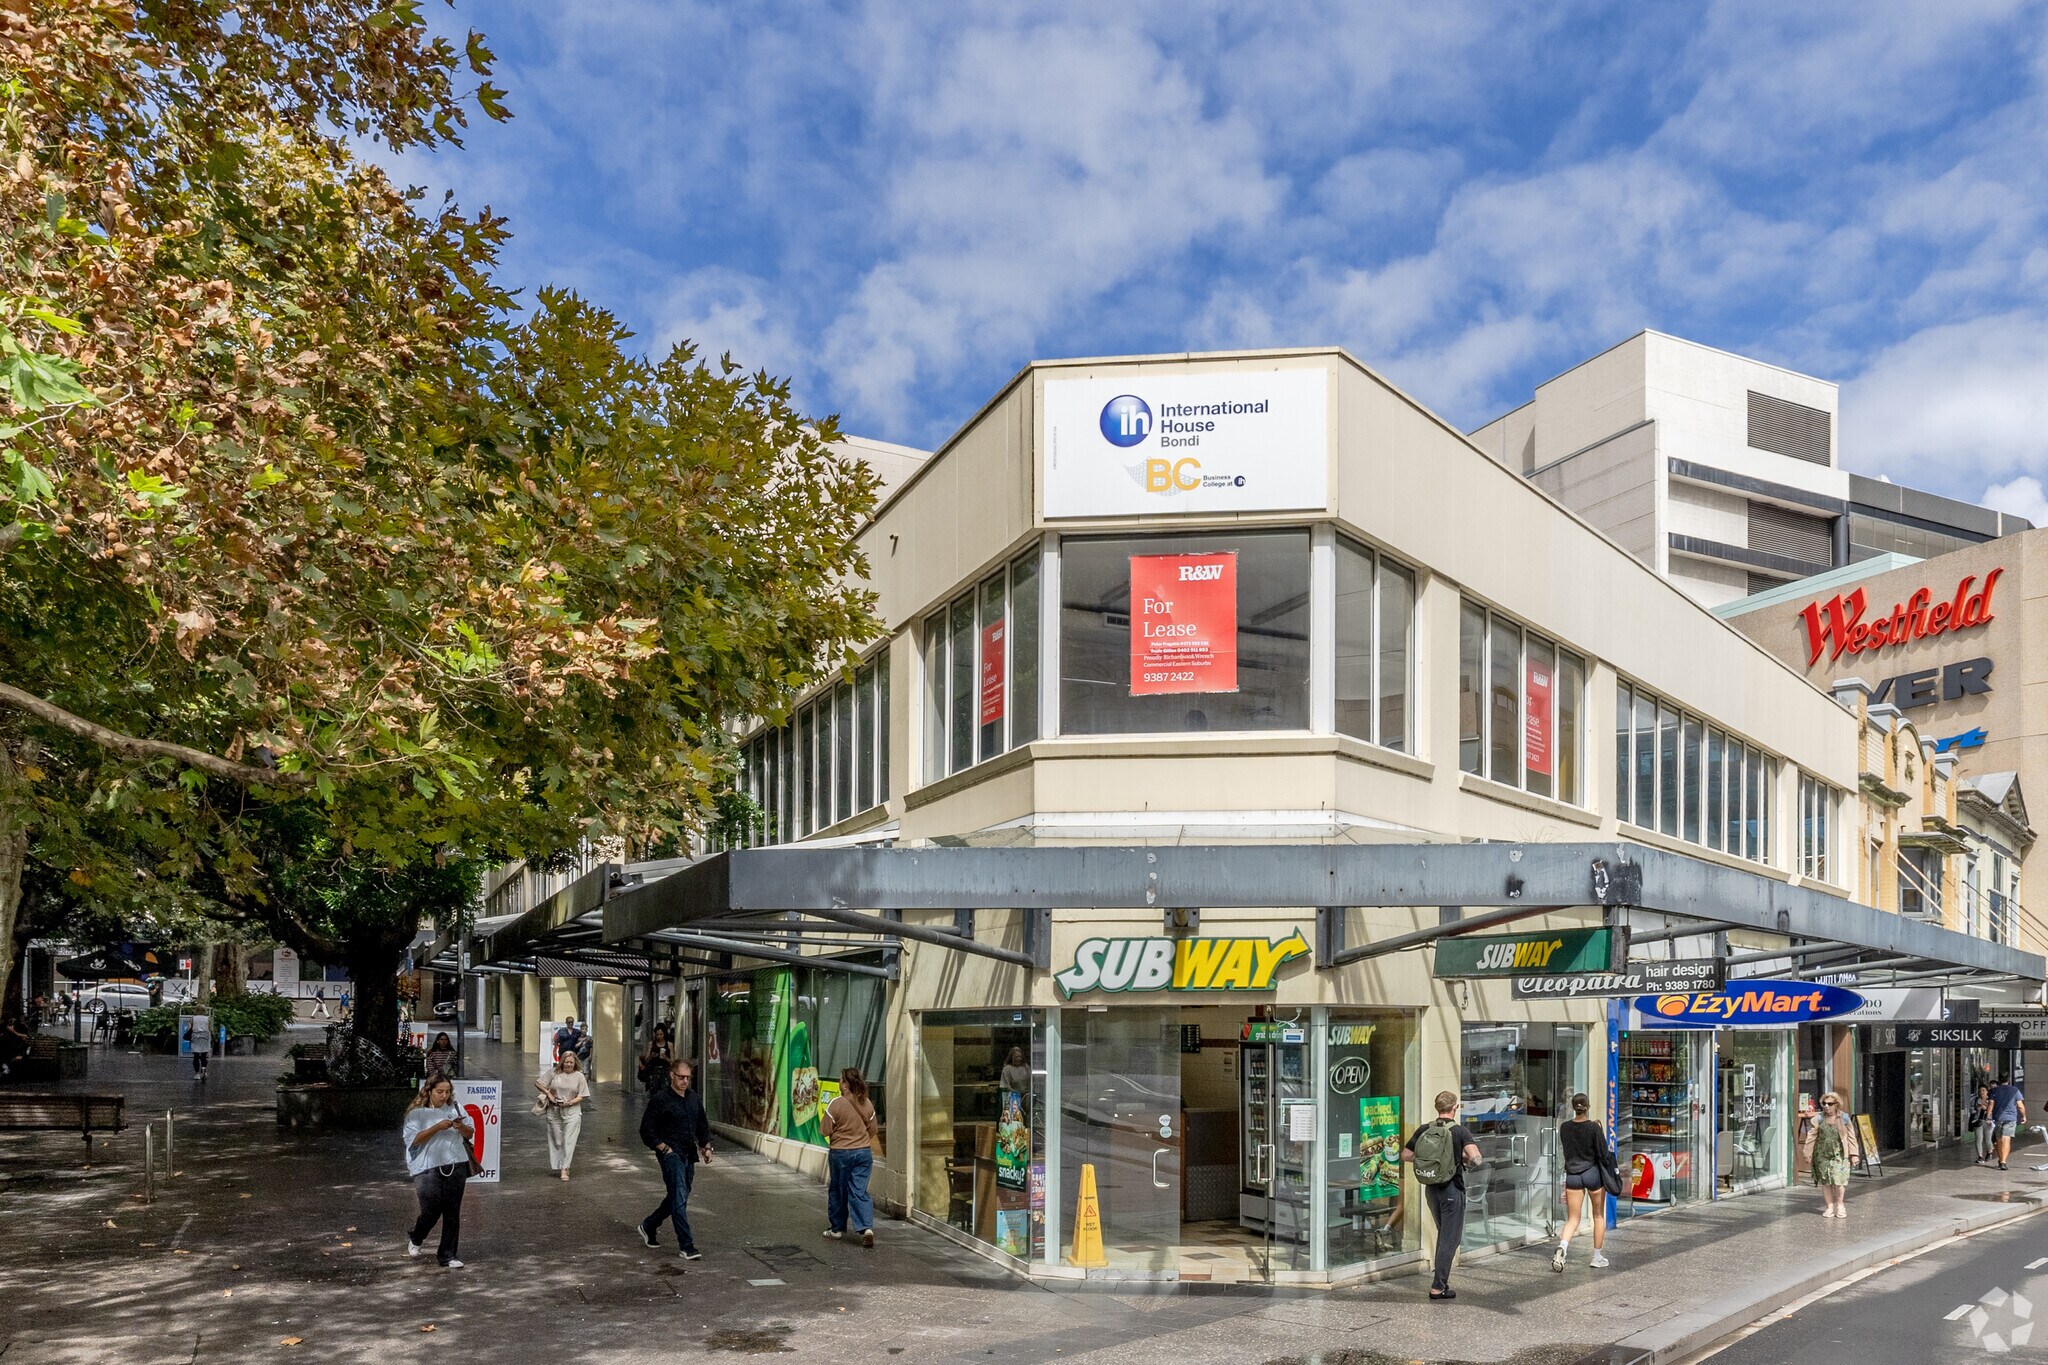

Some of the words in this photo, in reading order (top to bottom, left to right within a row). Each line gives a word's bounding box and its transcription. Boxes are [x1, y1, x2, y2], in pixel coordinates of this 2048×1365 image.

[1160, 399, 1269, 417] International
[1119, 405, 1150, 436] ih
[1160, 419, 1215, 434] House
[1160, 435, 1200, 447] Bondi
[1146, 457, 1201, 493] BC
[1179, 564, 1223, 581] R&W
[1143, 598, 1173, 614] For
[1798, 566, 2004, 667] Westfield
[1143, 621, 1197, 638] Lease
[1143, 672, 1168, 682] 9387
[1170, 671, 1194, 682] 2422
[1867, 657, 1994, 709] YER
[1935, 726, 1988, 753] rt
[1055, 926, 1312, 1000] SUBWAY
[1477, 939, 1563, 970] SUBWAY
[1645, 965, 1670, 978] hair
[1672, 964, 1714, 979] design
[1518, 974, 1643, 996] Cleopatra
[1646, 981, 1662, 992] Ph:
[1665, 980, 1689, 991] 9389
[1692, 979, 1715, 990] 1780
[1688, 989, 1824, 1018] EzyMart
[2020, 1020, 2047, 1030] OFF
[1328, 1024, 1376, 1045] SUBWAY
[1930, 1029, 1983, 1042] SIKSILK
[1335, 1065, 1365, 1085] OPEN
[467, 1086, 497, 1094] FASHION
[1363, 1101, 1393, 1120] packed.
[1371, 1113, 1399, 1130] protein
[479, 1169, 496, 1178] OFF
[998, 1166, 1025, 1185] snacky?
[1415, 1168, 1436, 1178] Chief.
